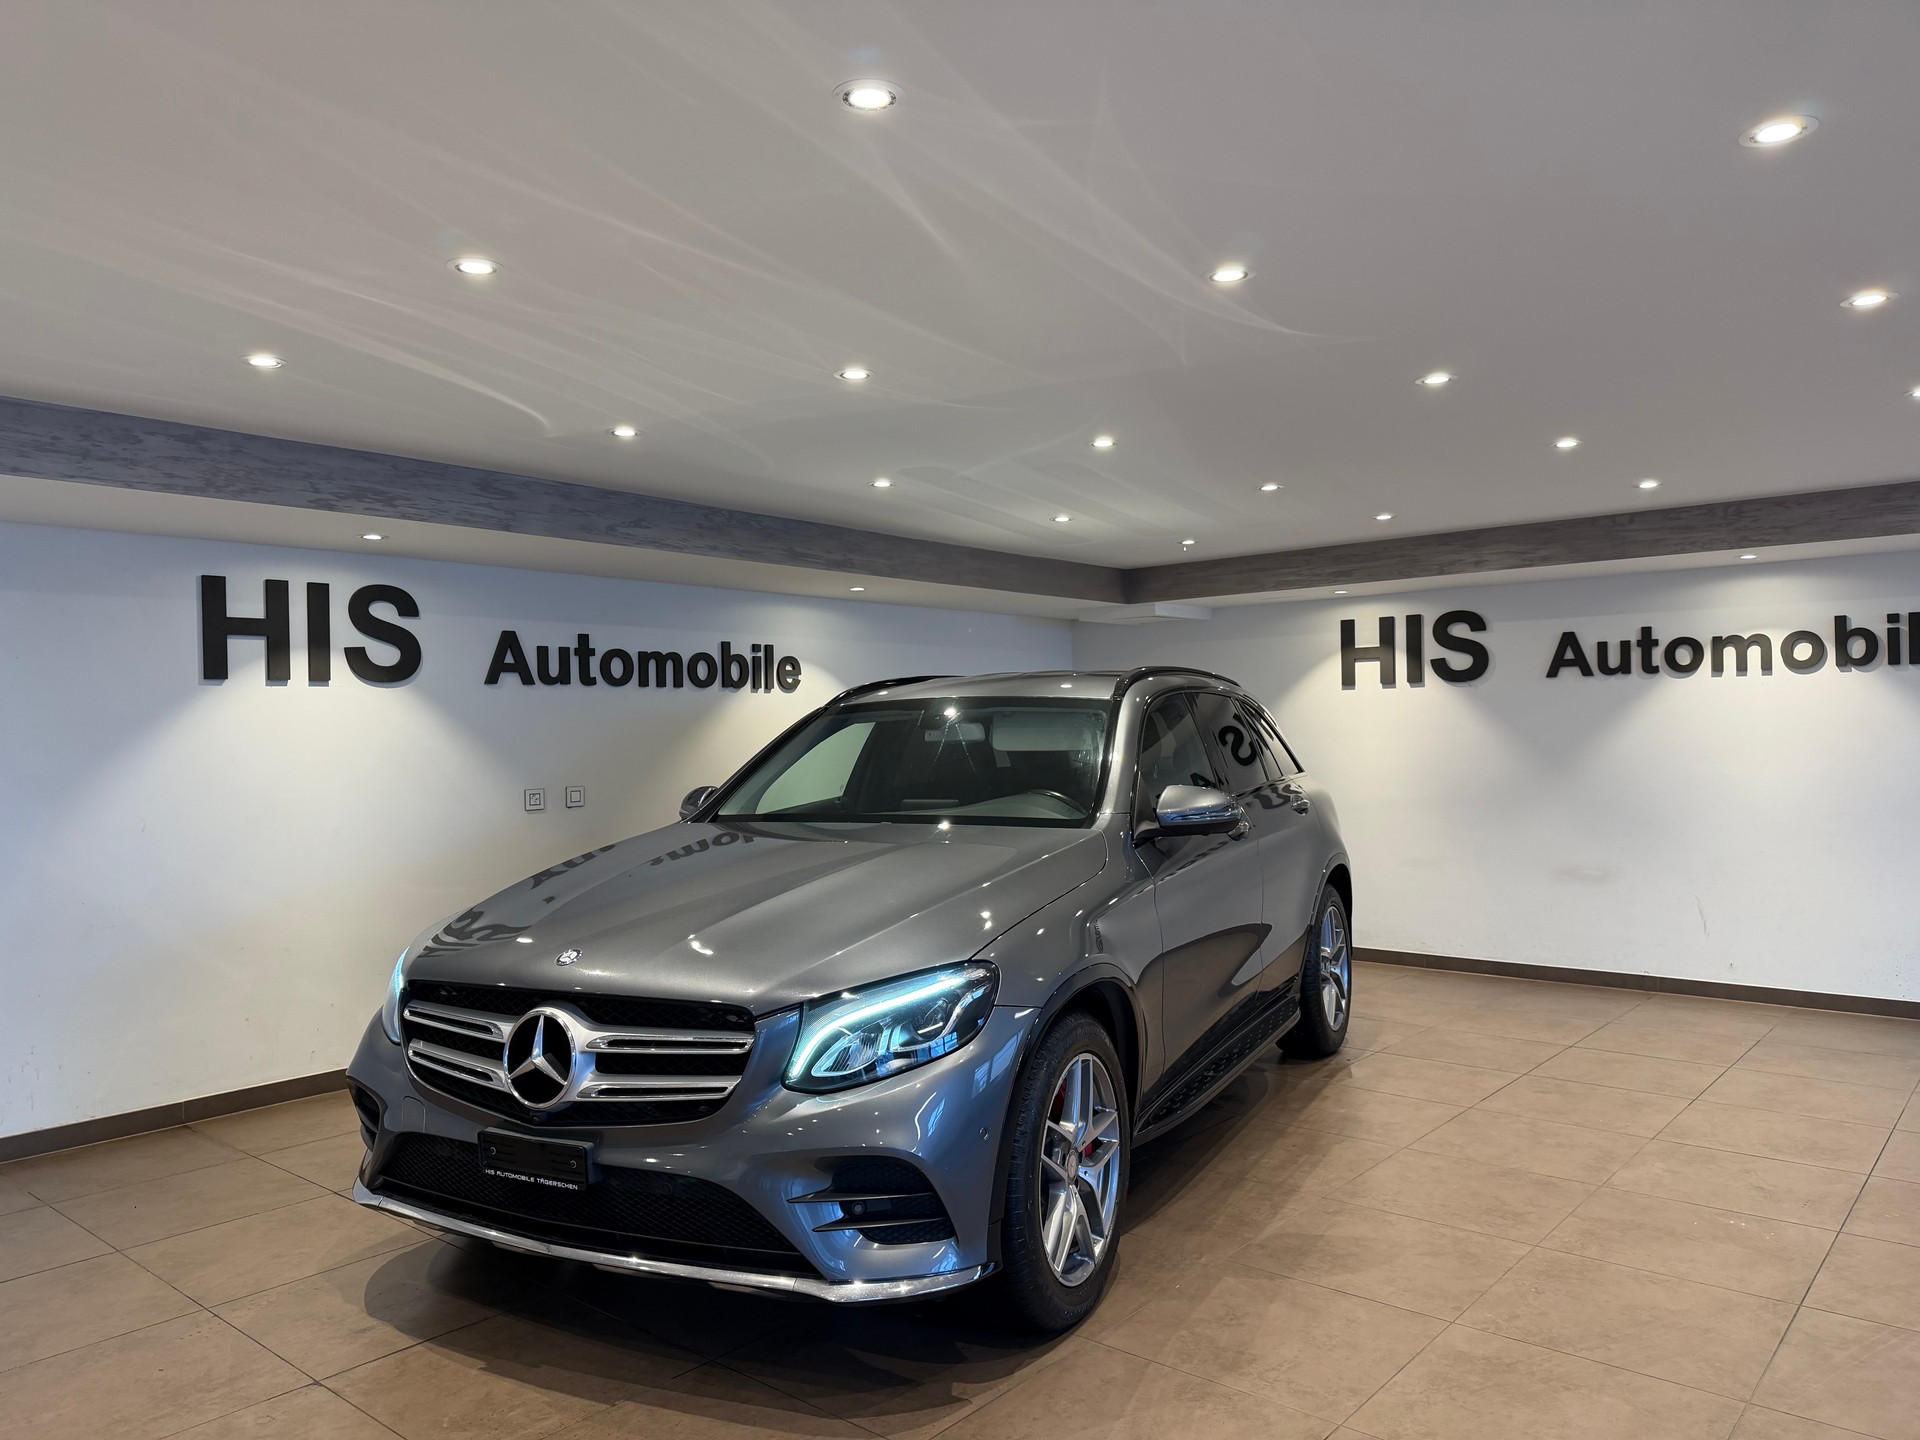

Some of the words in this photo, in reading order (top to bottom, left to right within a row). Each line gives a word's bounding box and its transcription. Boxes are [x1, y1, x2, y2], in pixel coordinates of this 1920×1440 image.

[200, 575, 421, 684] HIS
[484, 630, 802, 692] Automobile
[1340, 610, 1490, 689] HIS
[485, 1168, 495, 1176] HIS
[496, 1170, 535, 1183] AUTOMOBILE
